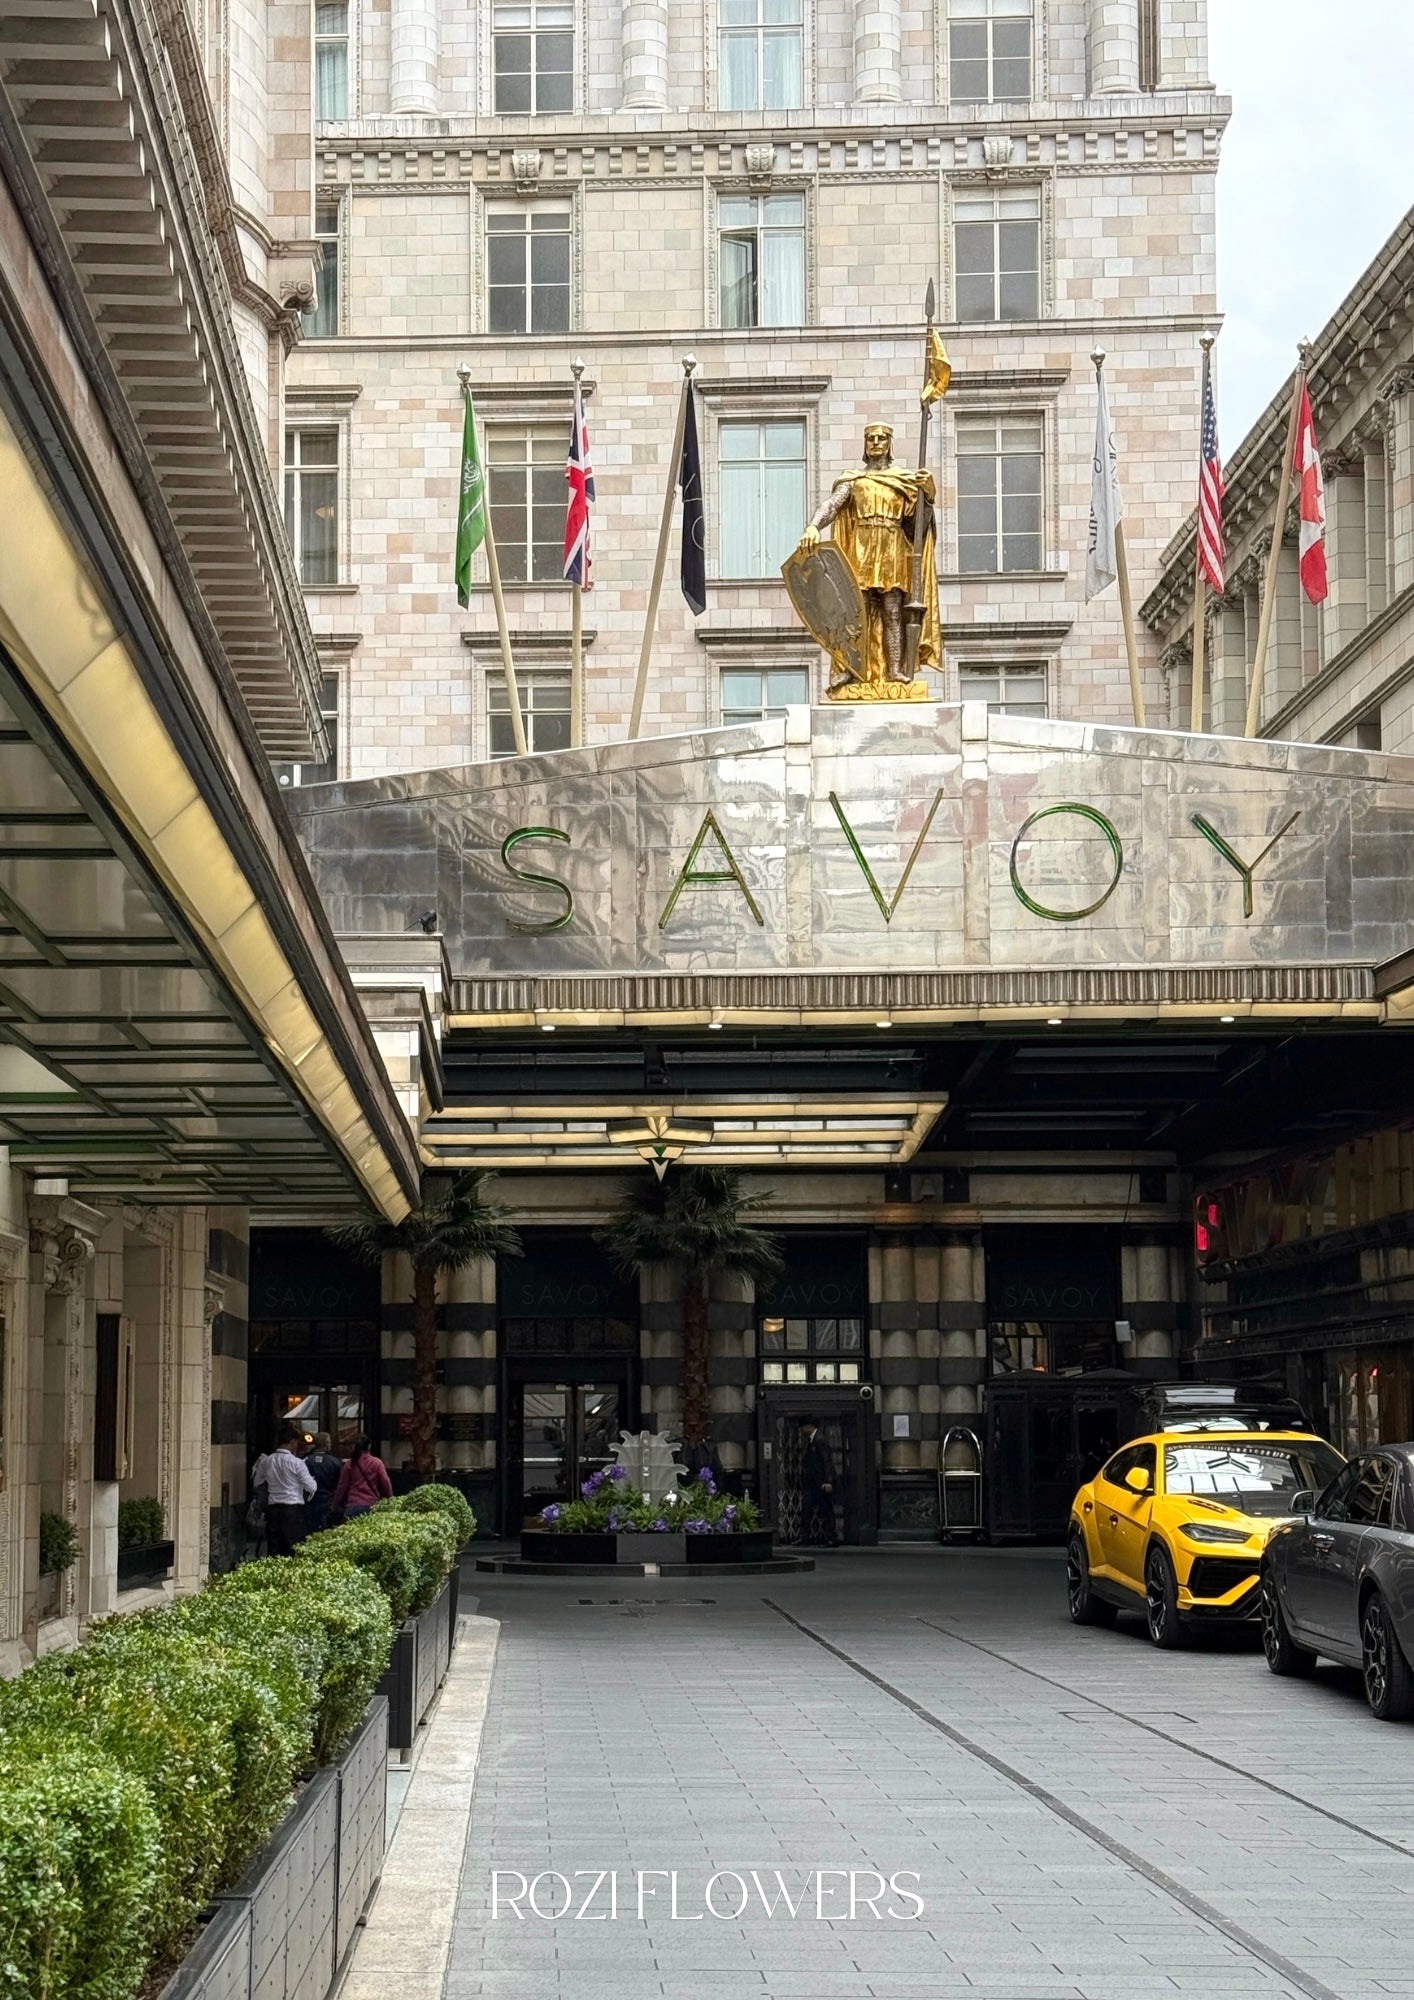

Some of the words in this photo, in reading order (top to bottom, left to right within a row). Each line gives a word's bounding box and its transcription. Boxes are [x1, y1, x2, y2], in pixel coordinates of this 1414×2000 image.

[848, 683, 916, 699] SAVOY
[501, 788, 1302, 932] SAVOY
[264, 1287, 358, 1310] SAVOY
[520, 1284, 616, 1306] SAVOY
[763, 1283, 858, 1305] SAVOY
[1004, 1287, 1101, 1309] SAVOY
